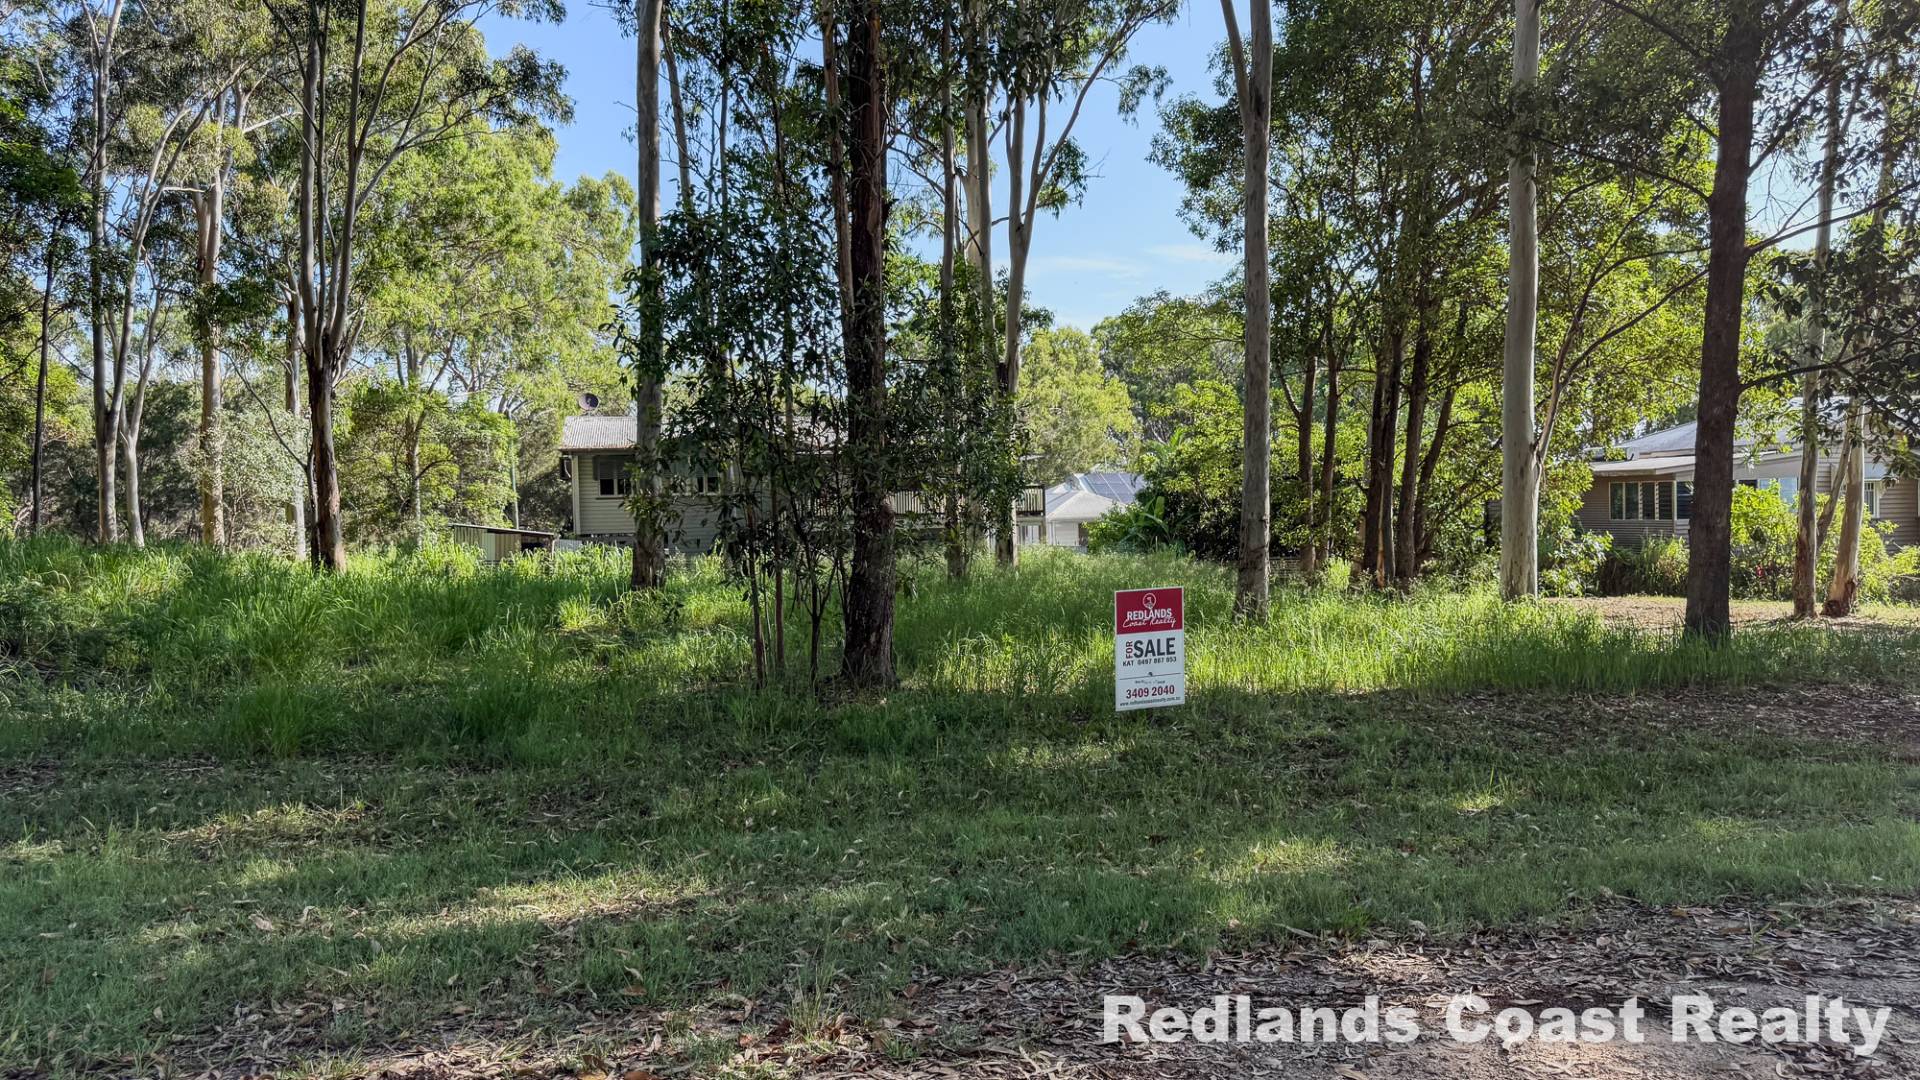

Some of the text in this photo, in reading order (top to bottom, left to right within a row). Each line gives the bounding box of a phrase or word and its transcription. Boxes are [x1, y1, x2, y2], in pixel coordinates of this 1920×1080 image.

[1127, 608, 1172, 621] REDLANDS
[1123, 618, 1147, 628] Coast
[1133, 637, 1176, 658] SALE
[1126, 684, 1175, 699] 3409 2040
